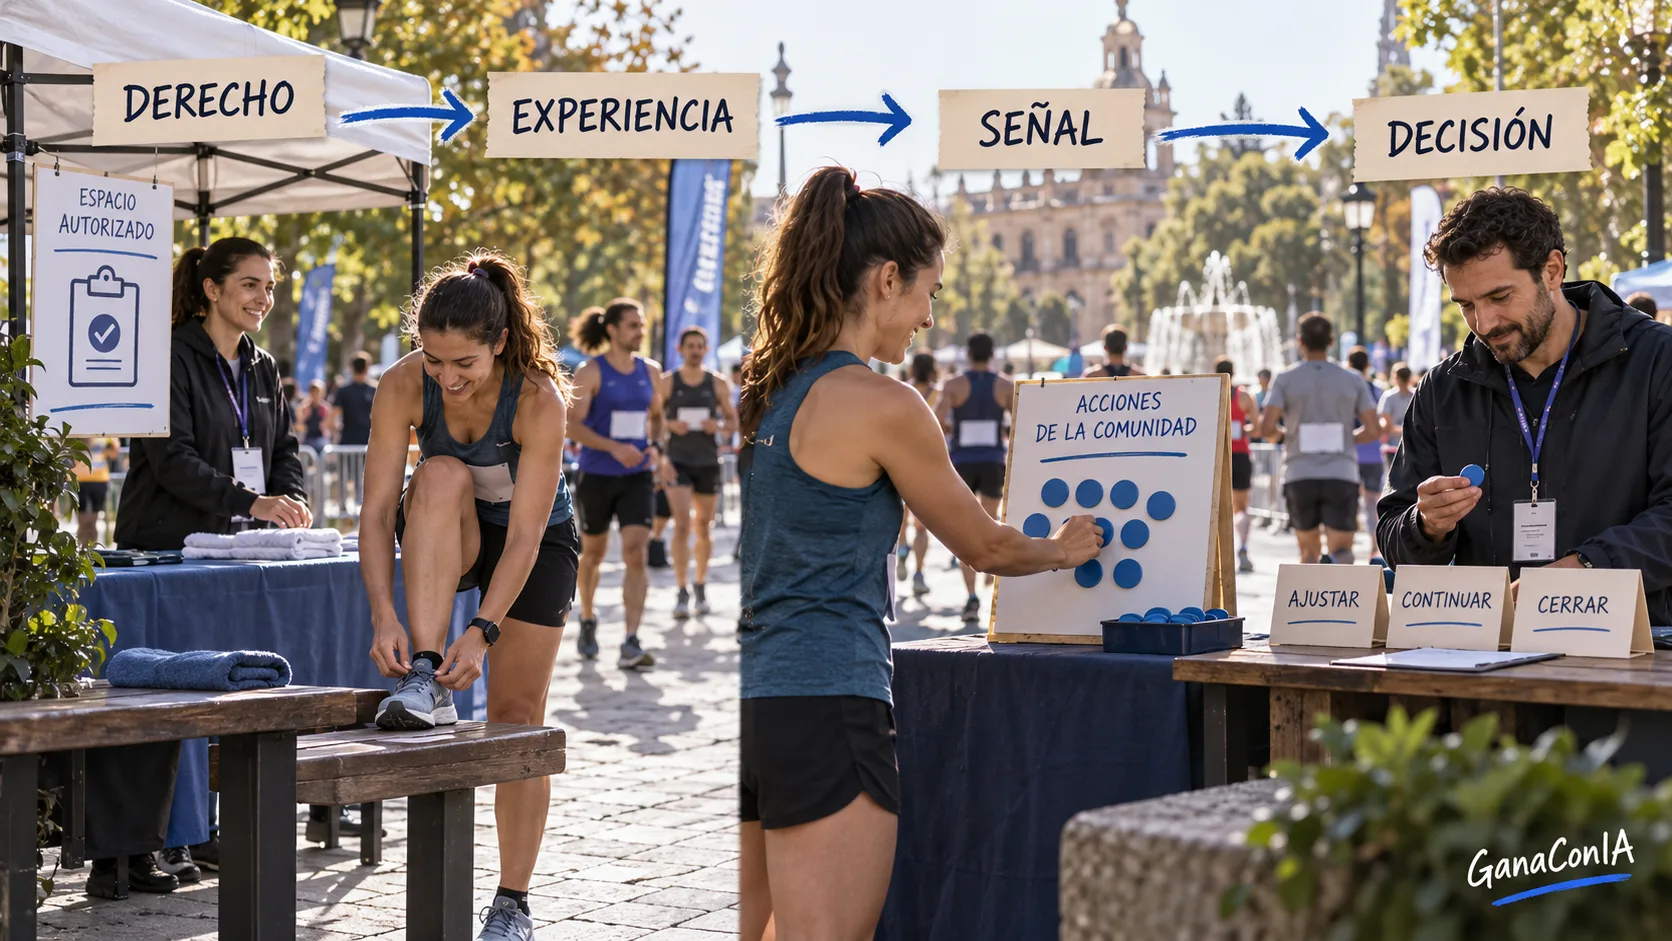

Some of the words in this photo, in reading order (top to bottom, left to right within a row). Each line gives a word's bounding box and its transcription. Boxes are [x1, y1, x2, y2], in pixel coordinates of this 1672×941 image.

[79, 187, 137, 212] ESPACIO
[58, 213, 155, 241] AUTORIZADO
[1075, 391, 1162, 414] ACCIONES
[1035, 423, 1058, 443] DE
[1064, 421, 1086, 441] LA
[1093, 416, 1197, 440] COMUNIDAD
[1287, 589, 1360, 608] AJUSTAR
[1401, 590, 1492, 610] CONTINUAR
[1537, 595, 1609, 615] CERRAR
